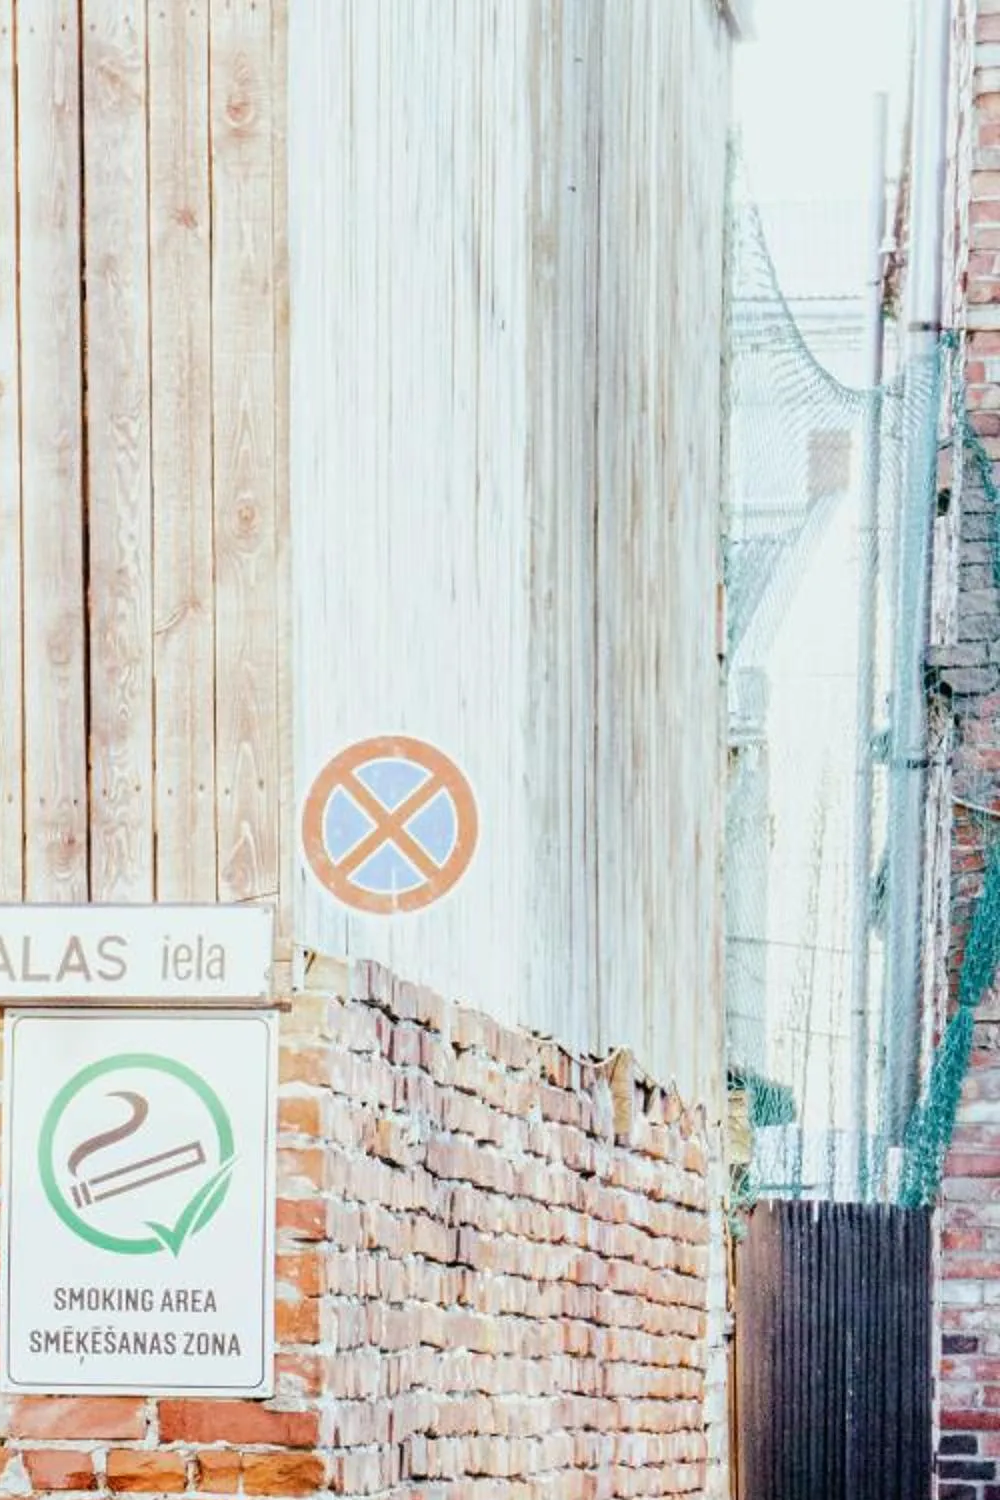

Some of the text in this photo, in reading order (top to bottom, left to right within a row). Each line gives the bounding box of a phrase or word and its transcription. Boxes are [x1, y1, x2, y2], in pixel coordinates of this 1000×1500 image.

[161, 935, 226, 981] iela
[53, 1287, 217, 1314] SMOKING AREA
[28, 1325, 242, 1364] SMĒĶĒŠANAS ZONA
